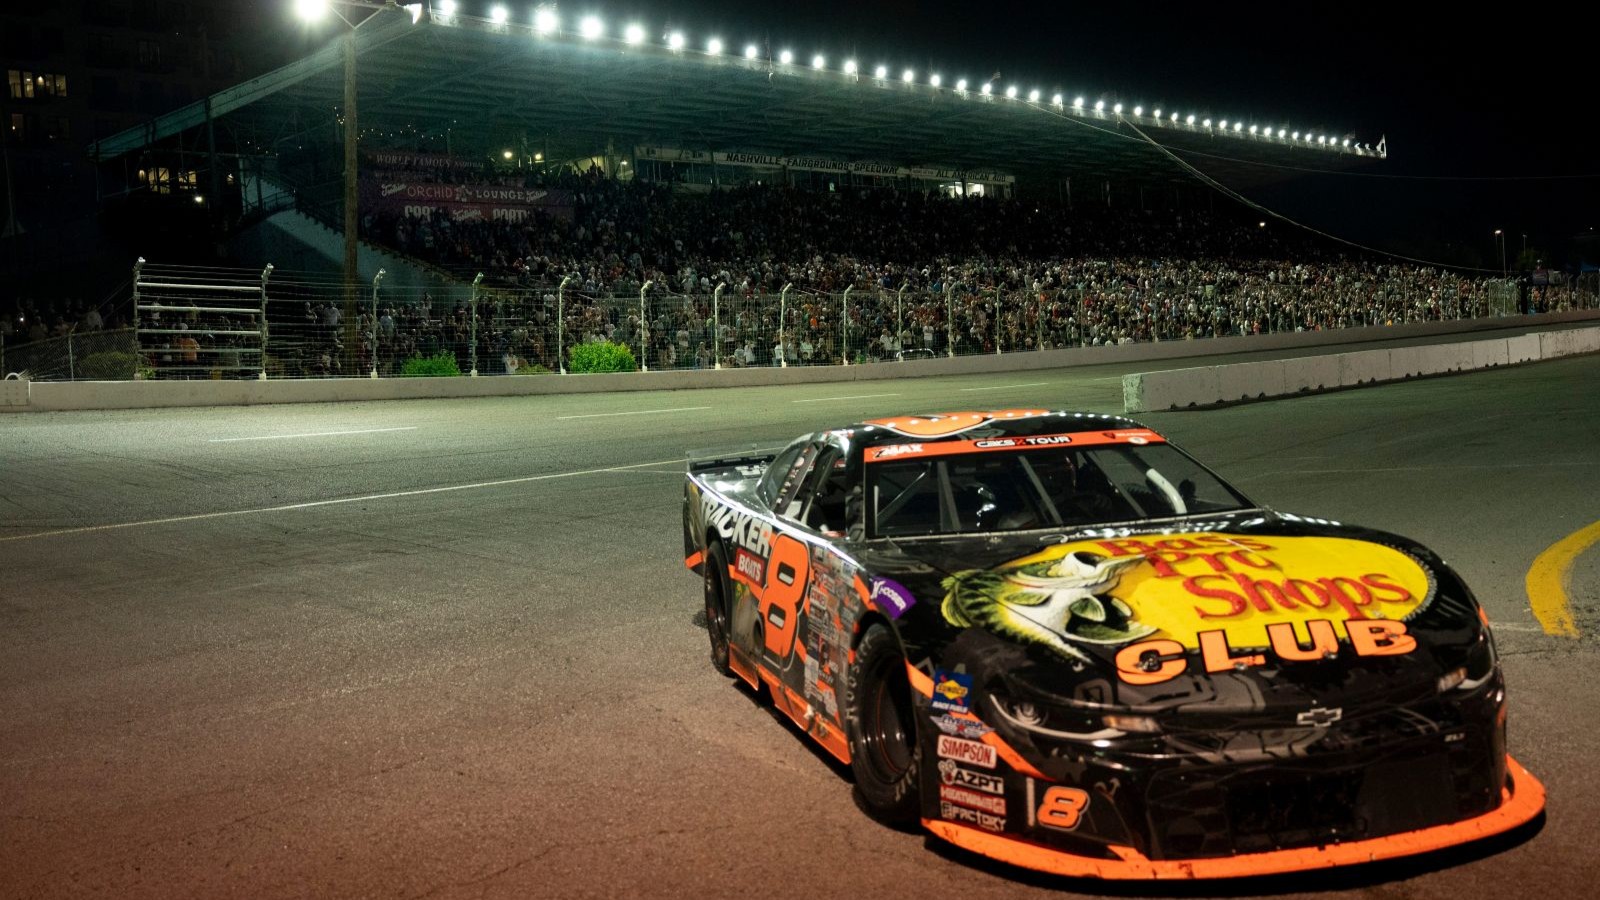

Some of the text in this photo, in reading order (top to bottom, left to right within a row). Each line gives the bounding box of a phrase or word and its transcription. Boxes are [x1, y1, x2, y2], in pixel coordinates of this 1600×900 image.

[726, 153, 898, 174] NASHVILLE FAIRGROUNDS SPEEDWAY
[407, 185, 453, 199] ORCHID
[476, 189, 524, 201] LOUNGE
[1026, 436, 1070, 445] TOUR
[1094, 532, 1272, 558] Bass
[738, 554, 763, 583] BOATS
[1143, 547, 1274, 578] Pro
[759, 532, 812, 670] 8
[1182, 571, 1412, 620] Shops
[1115, 618, 1418, 686] CLUB
[941, 739, 992, 764] SIMPSON
[954, 770, 1002, 792] AZPT
[1037, 786, 1091, 832] 8
